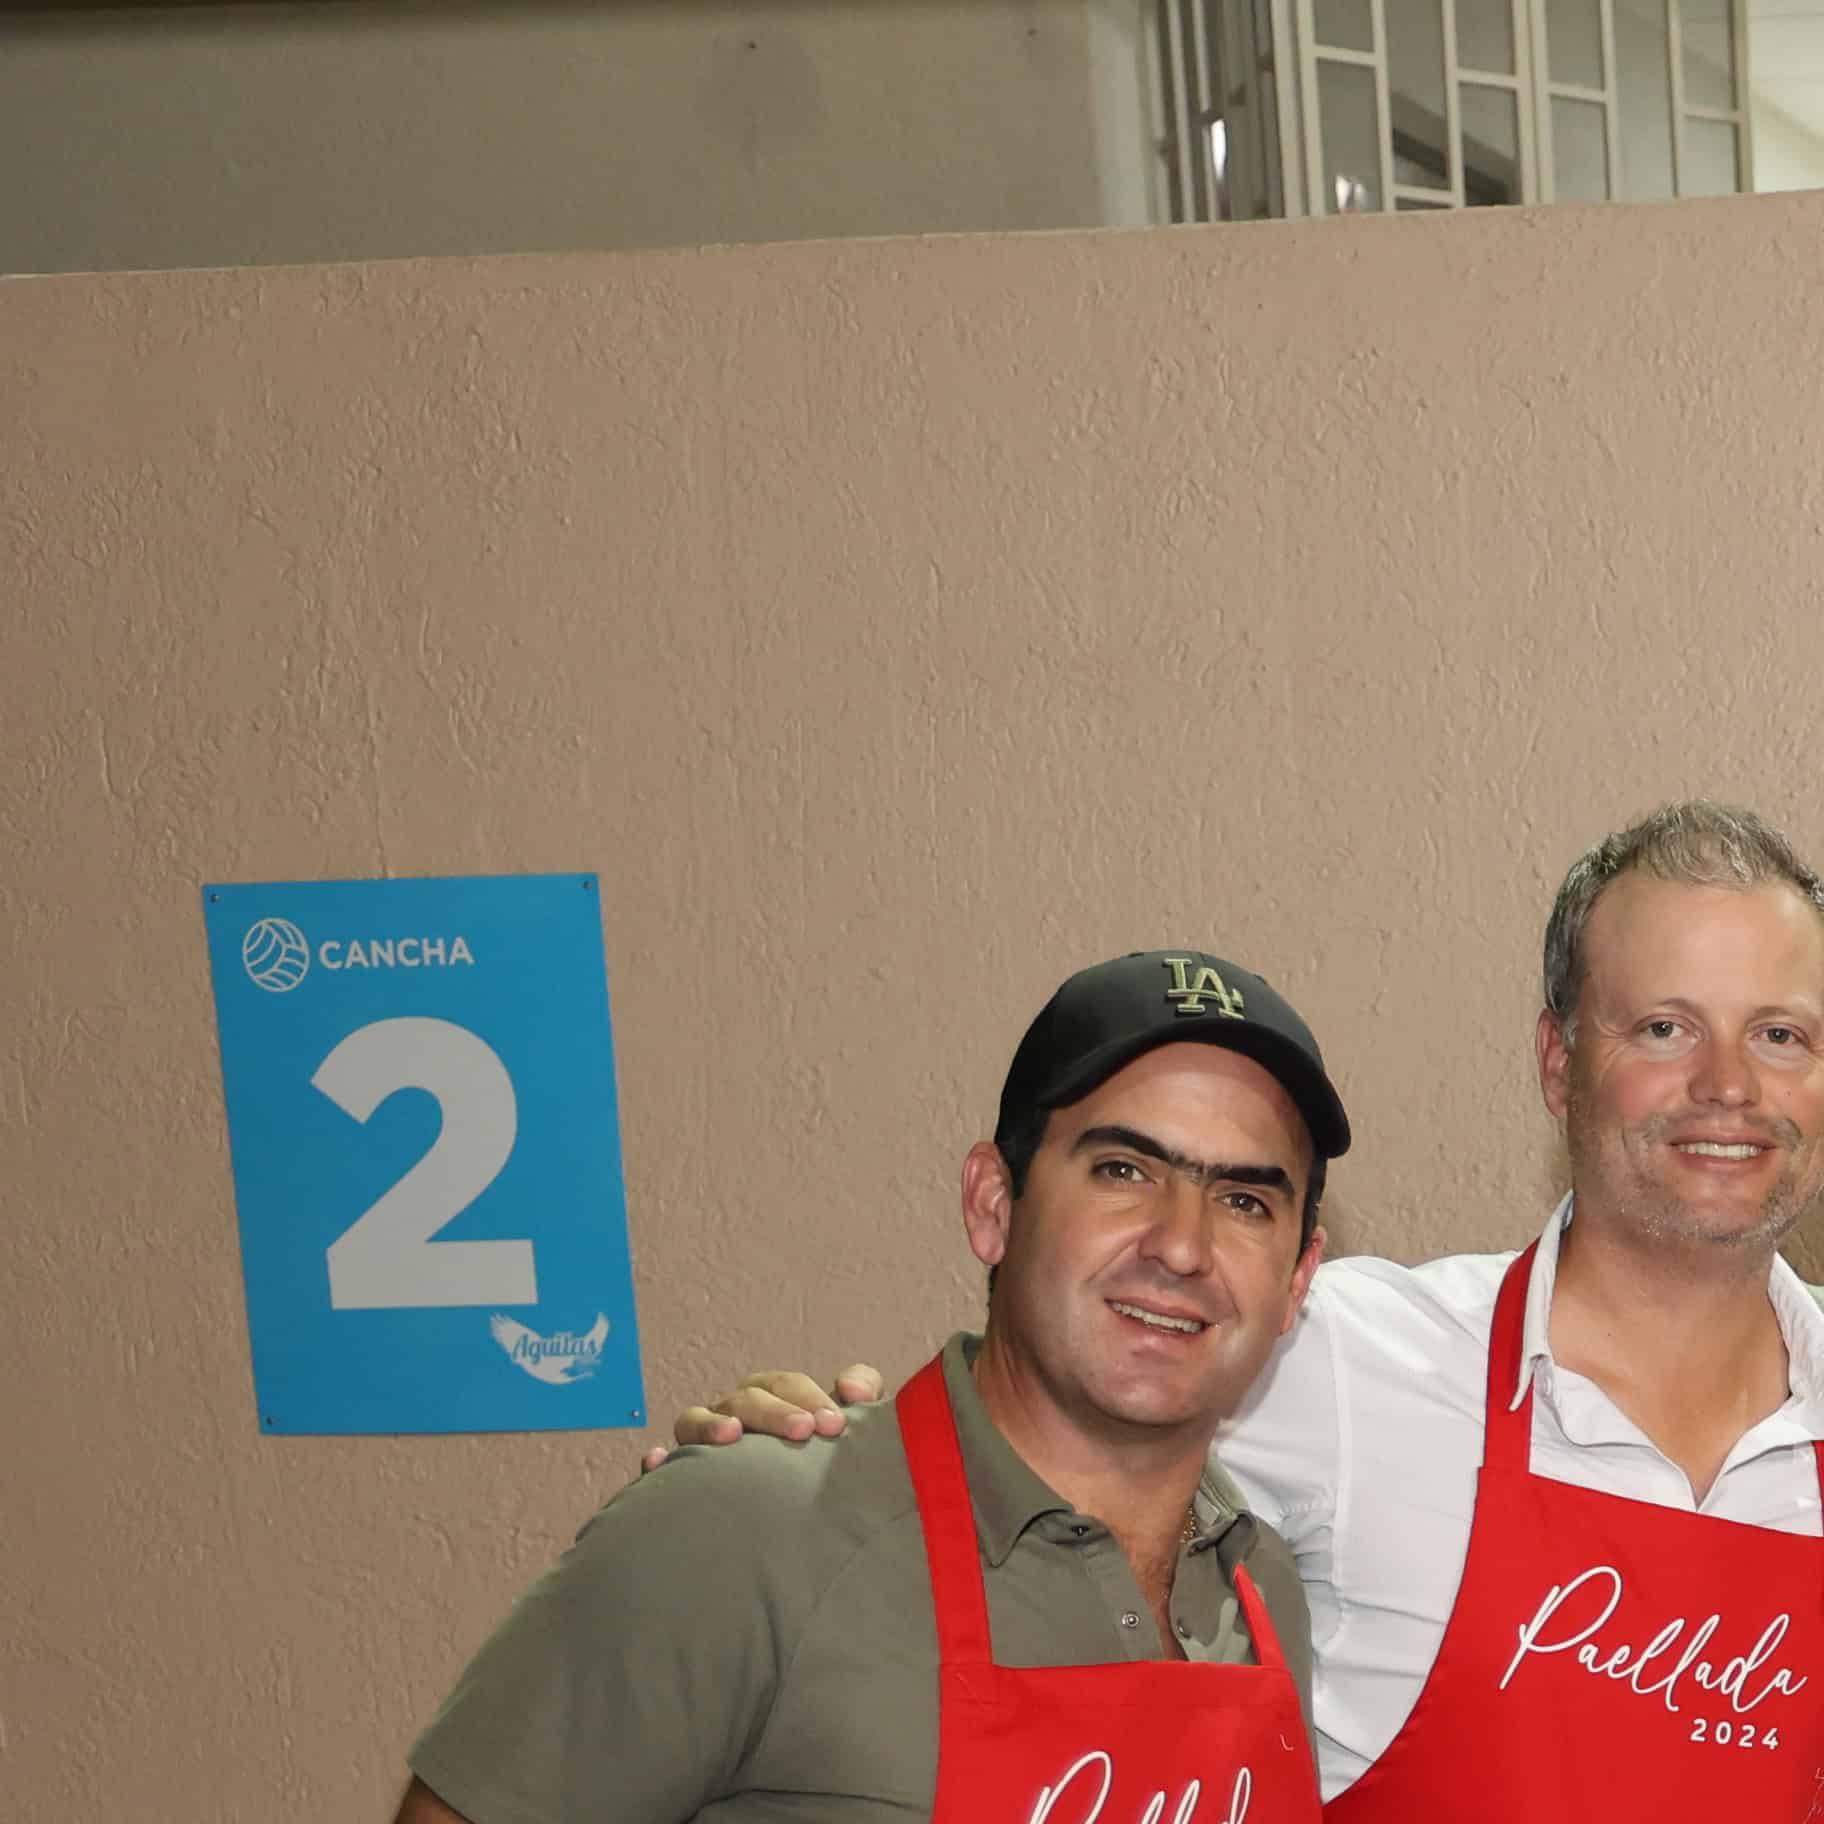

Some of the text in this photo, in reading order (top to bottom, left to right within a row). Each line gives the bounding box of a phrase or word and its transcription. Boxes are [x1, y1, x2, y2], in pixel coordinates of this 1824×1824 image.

[320, 937, 473, 969] CANCHA
[1163, 957, 1246, 1019] LA
[311, 1016, 538, 1309] 2
[1500, 1566, 1807, 1712] Paellada
[1691, 1718, 1779, 1749] 2024
